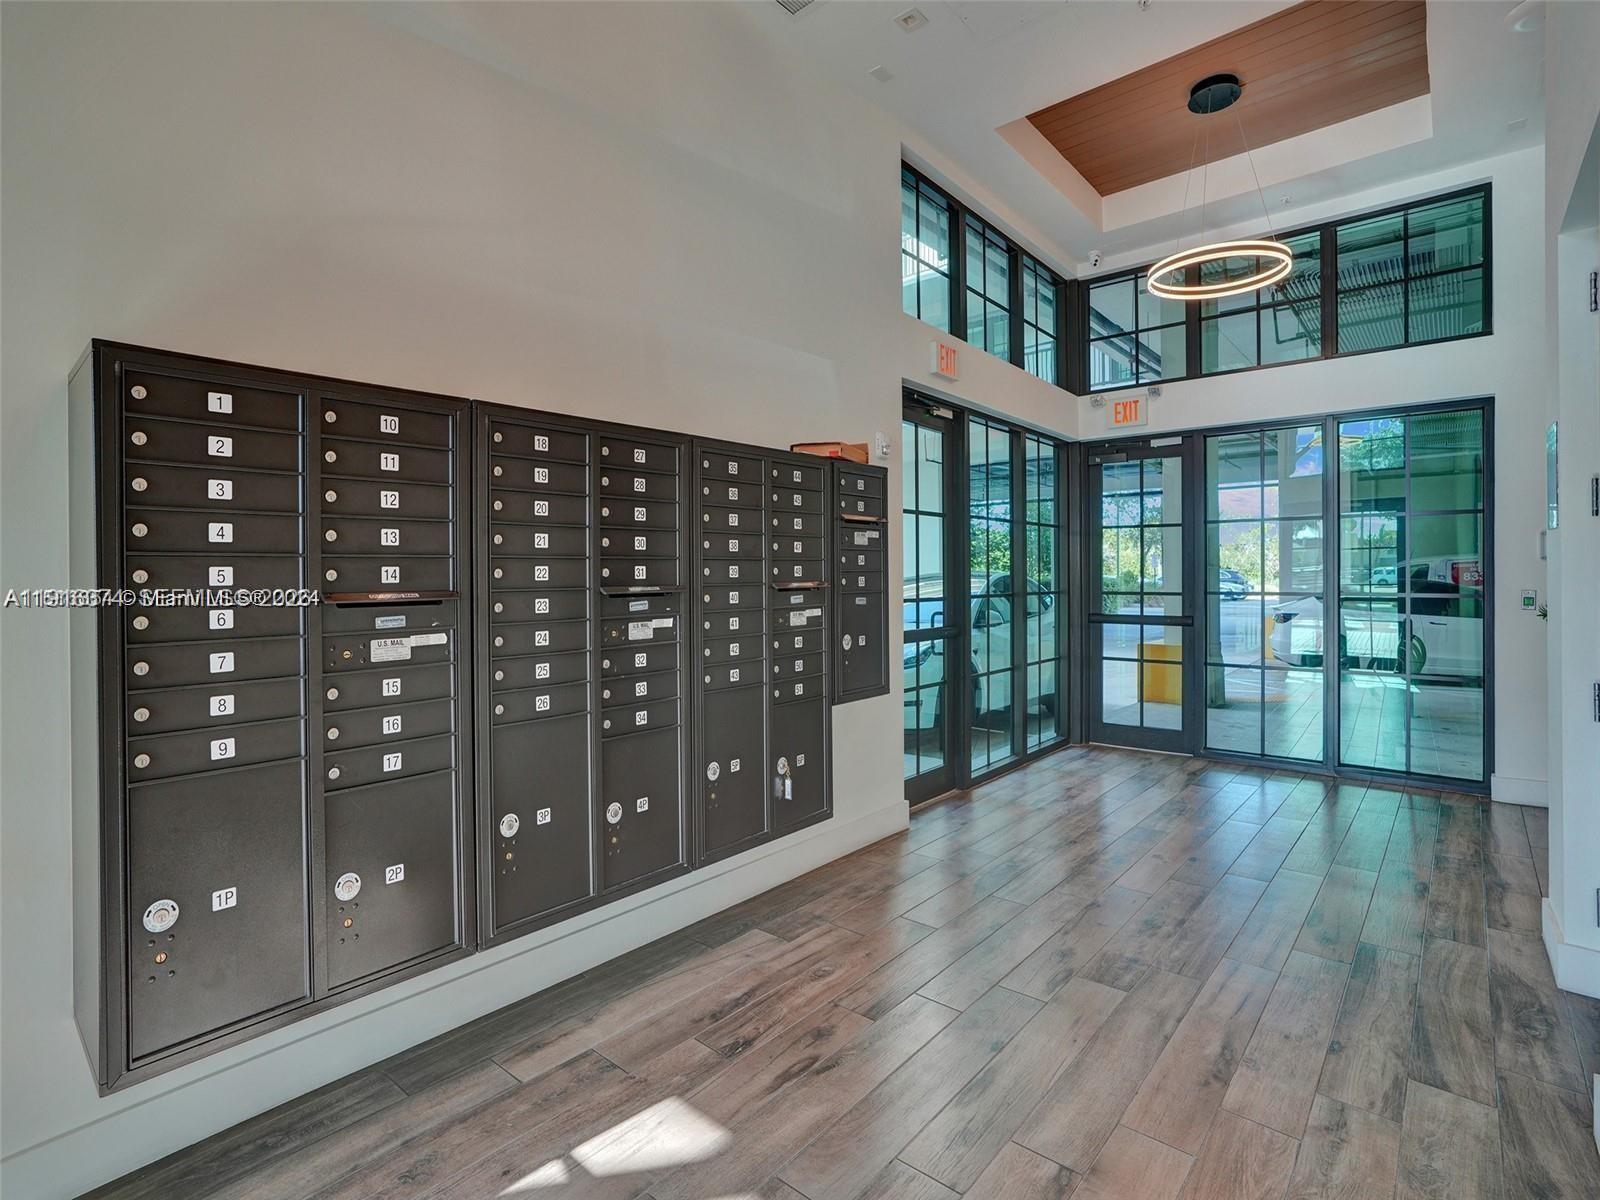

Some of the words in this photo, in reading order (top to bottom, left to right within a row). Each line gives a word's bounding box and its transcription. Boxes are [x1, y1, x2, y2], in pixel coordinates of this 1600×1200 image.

[938, 344, 957, 376] EXIT
[1114, 400, 1139, 425] EXIT
[383, 418, 397, 432] 10
[216, 439, 225, 454] 2
[536, 438, 547, 450] 18
[635, 450, 644, 461] 27
[384, 456, 395, 468] 11
[537, 470, 547, 481] 19
[216, 482, 225, 497] 3
[635, 479, 645, 490] 28
[384, 493, 397, 506] 12
[536, 502, 547, 514] 20
[636, 509, 645, 520] 29
[216, 526, 226, 540] 4
[384, 531, 398, 544] 13
[536, 535, 546, 546] 21
[636, 538, 646, 549] 30
[216, 569, 226, 584] 5
[384, 569, 398, 581] 14
[536, 568, 547, 579] 22
[636, 567, 644, 578] 31
[536, 600, 548, 612] 23
[217, 612, 226, 627] 6
[536, 632, 547, 644] 24
[217, 655, 226, 670] 7
[636, 654, 646, 666] 32
[537, 665, 548, 677] 25
[385, 680, 399, 694] 15
[636, 683, 646, 695] 33
[218, 698, 227, 713] 8
[537, 697, 548, 709] 26
[637, 712, 646, 724] 34
[386, 718, 399, 731] 16
[218, 742, 228, 756] 9
[386, 755, 400, 769] 17
[638, 799, 648, 810] 4P
[538, 810, 550, 823] 3P
[388, 866, 402, 882] 2P
[216, 890, 234, 907] 1P
